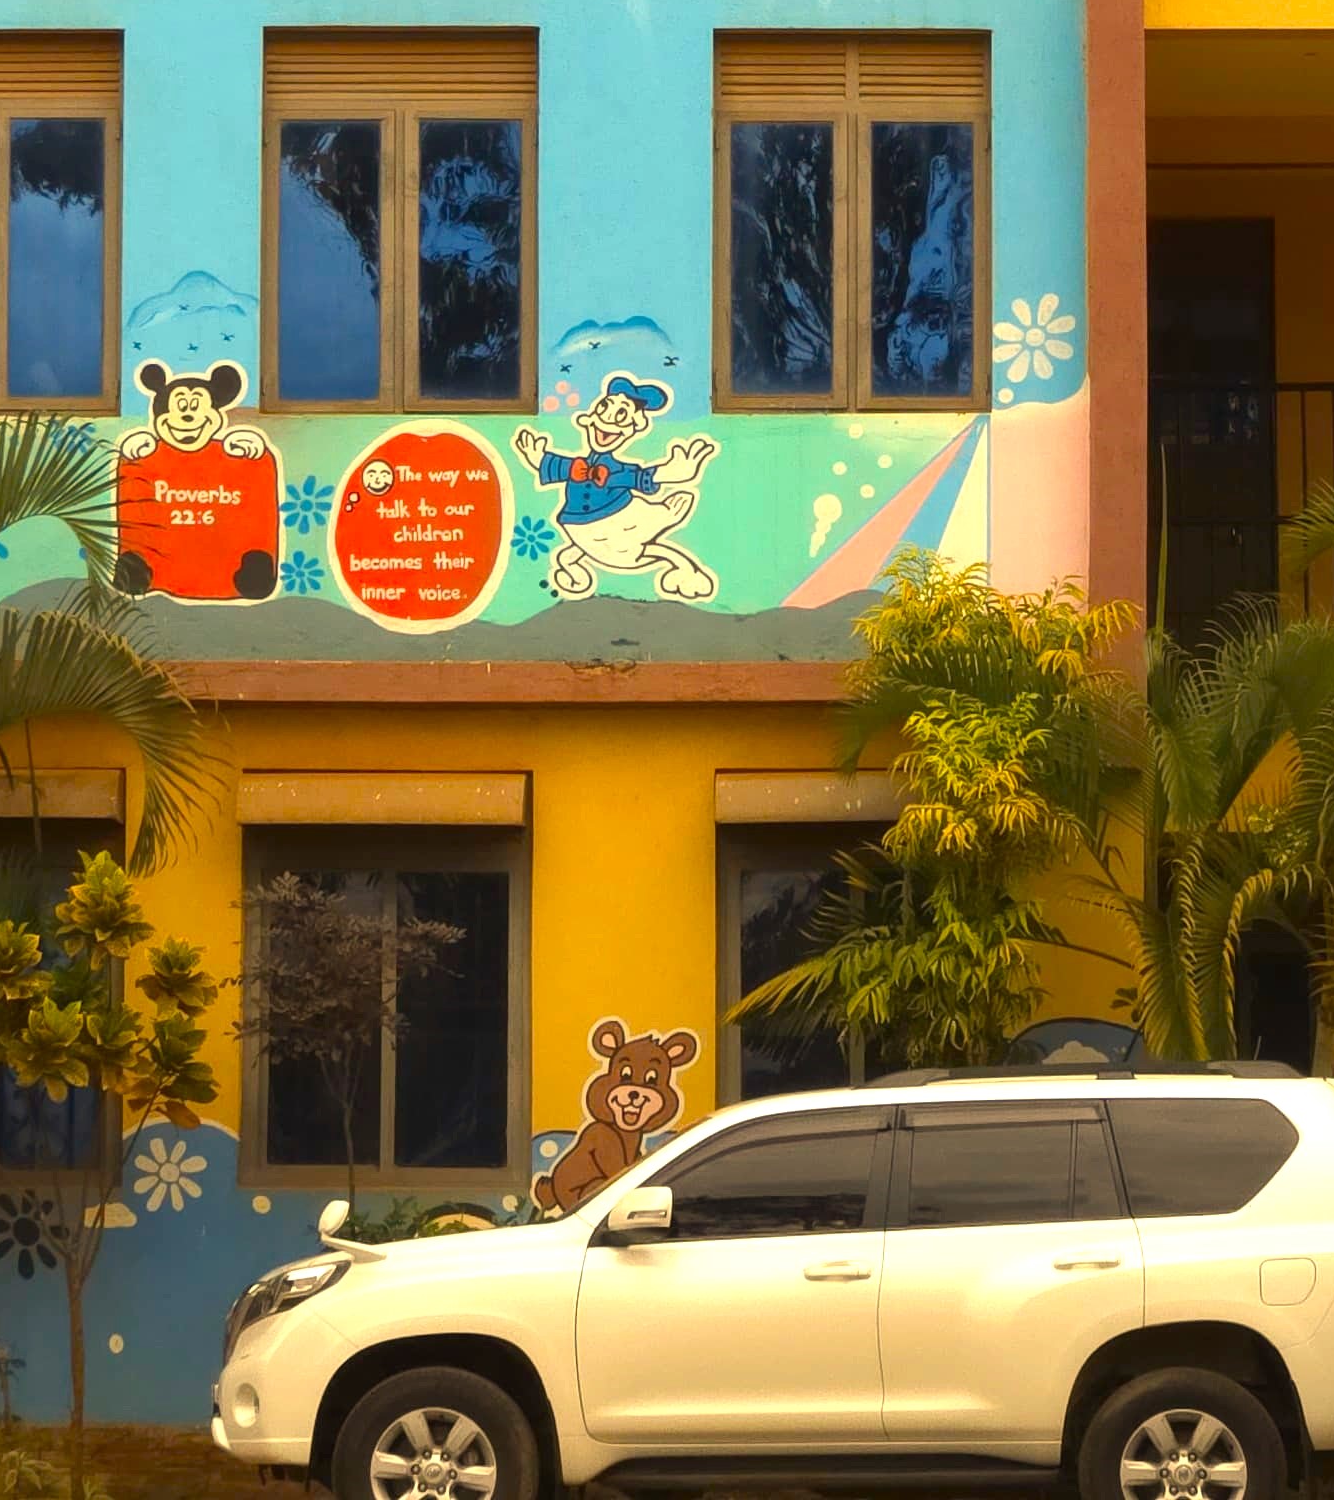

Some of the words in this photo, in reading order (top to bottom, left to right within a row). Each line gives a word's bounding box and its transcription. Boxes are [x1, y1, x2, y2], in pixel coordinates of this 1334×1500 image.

[395, 465, 422, 482] The
[428, 470, 460, 488] way
[466, 469, 490, 482] we
[154, 480, 242, 505] Proverbs
[170, 509, 216, 525] 22:6
[376, 500, 410, 519] talk
[418, 498, 438, 517] to
[444, 504, 475, 517] our
[349, 554, 423, 572] becomes
[433, 551, 475, 570] their
[361, 583, 406, 601] inner
[418, 584, 468, 601] voice.
